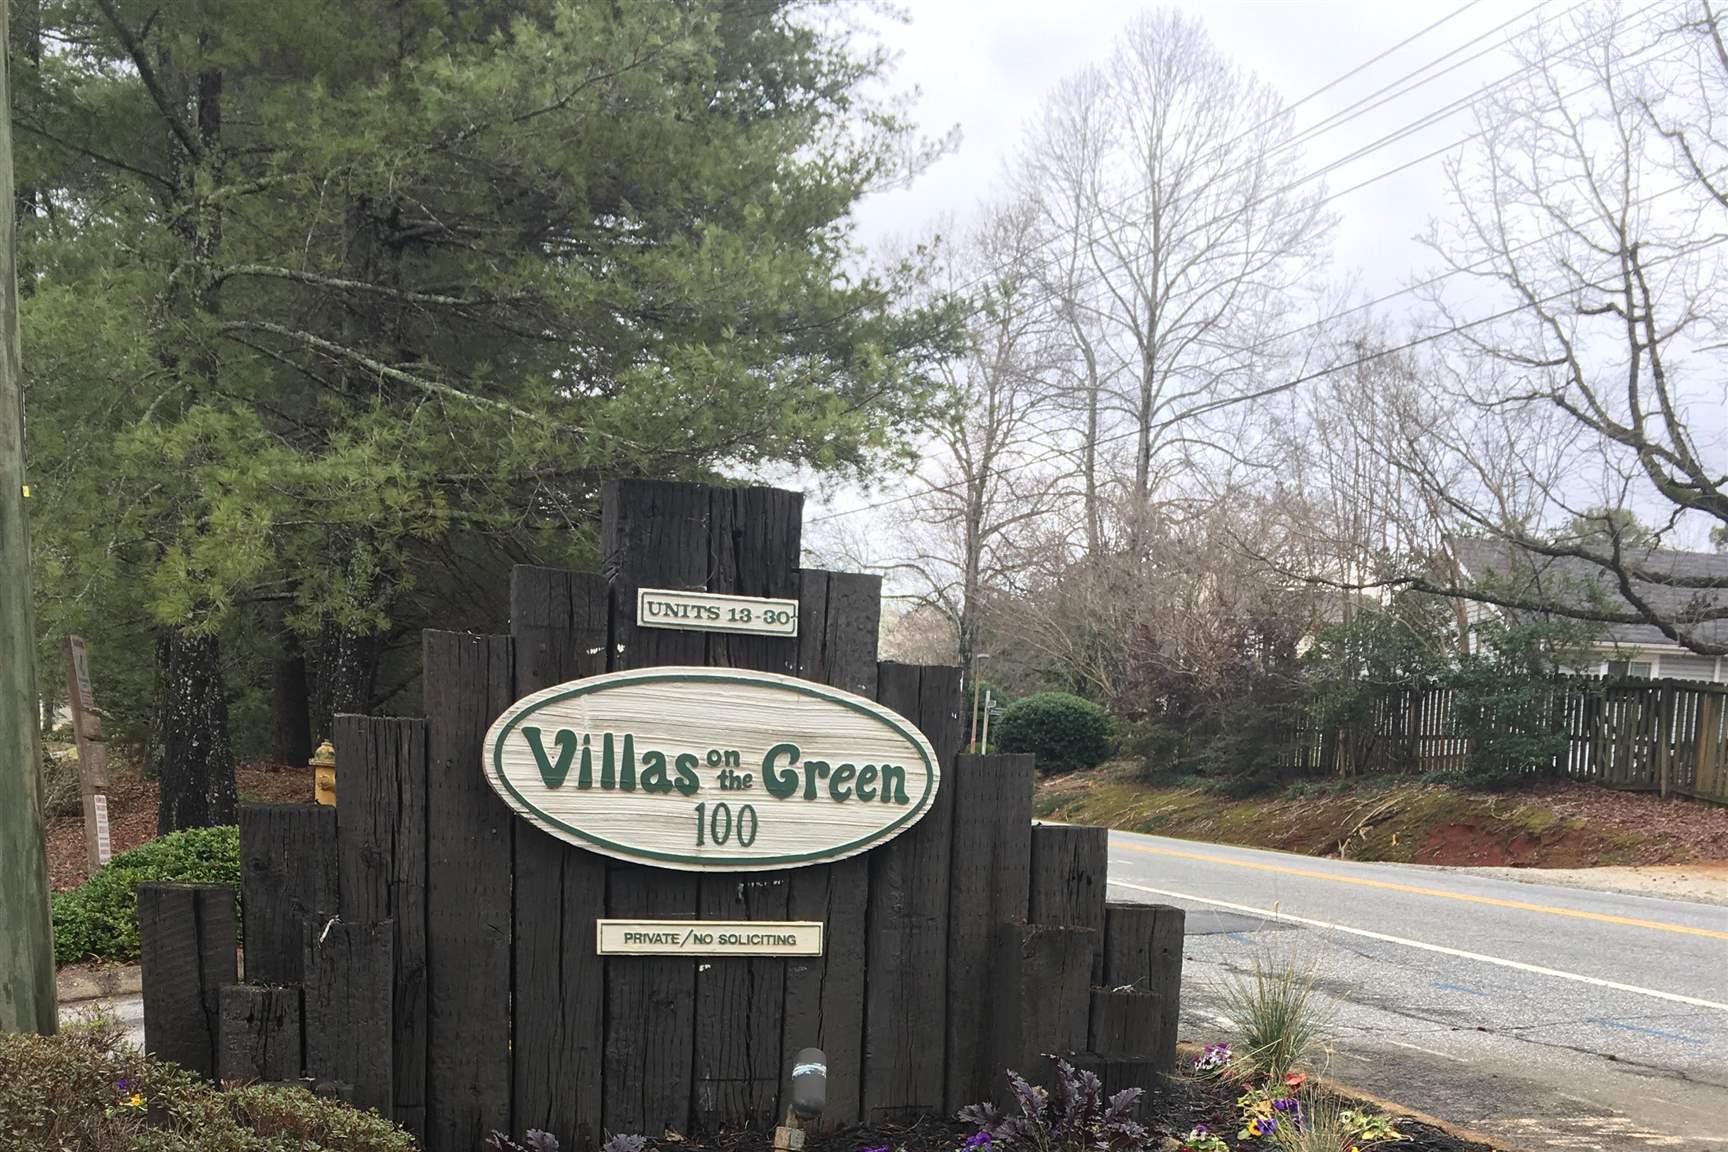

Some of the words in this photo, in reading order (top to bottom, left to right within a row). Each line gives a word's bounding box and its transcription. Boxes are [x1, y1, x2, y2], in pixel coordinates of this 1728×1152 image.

[647, 601, 720, 620] UNITS
[727, 607, 790, 625] 13-30
[521, 726, 699, 796] Villas
[706, 749, 740, 767] on
[717, 769, 753, 790] the
[762, 743, 910, 805] Green
[694, 802, 758, 847] 100
[718, 934, 797, 946] SOLICITING
